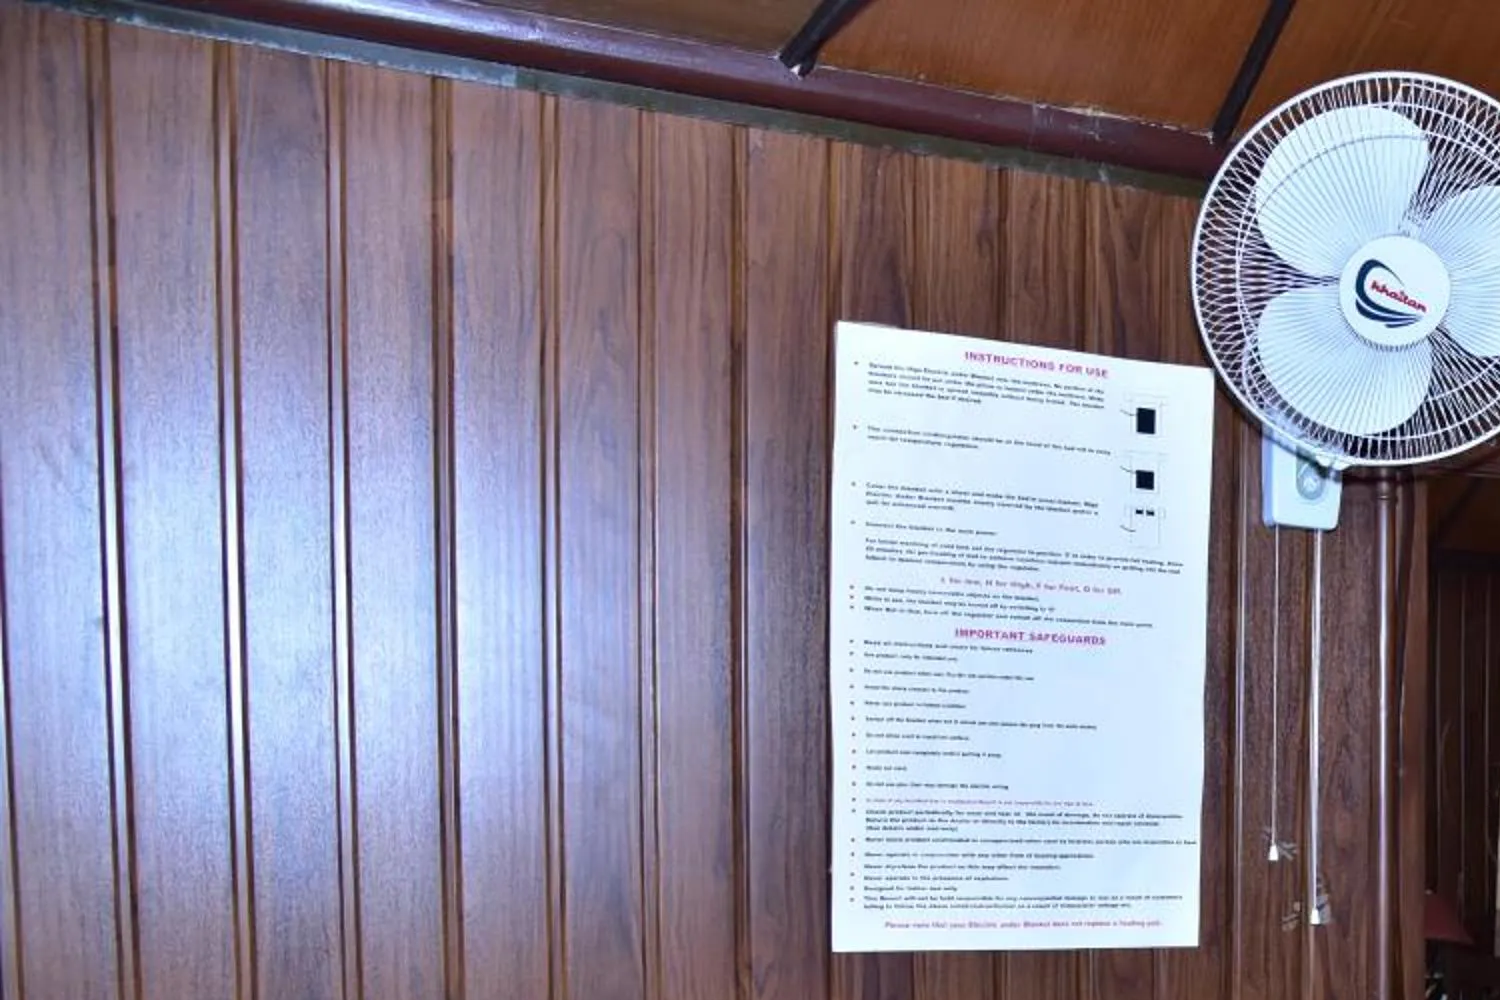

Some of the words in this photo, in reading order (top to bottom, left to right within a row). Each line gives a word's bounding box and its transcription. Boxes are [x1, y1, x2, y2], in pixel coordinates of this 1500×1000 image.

[1369, 279, 1427, 313] khaitan
[964, 350, 1055, 371] INSTRUCTIONS
[1058, 362, 1082, 374] FOR
[1085, 365, 1107, 377] USE
[954, 627, 1024, 641] IMPORTANT
[1028, 632, 1107, 645] SAFEGUARDS
